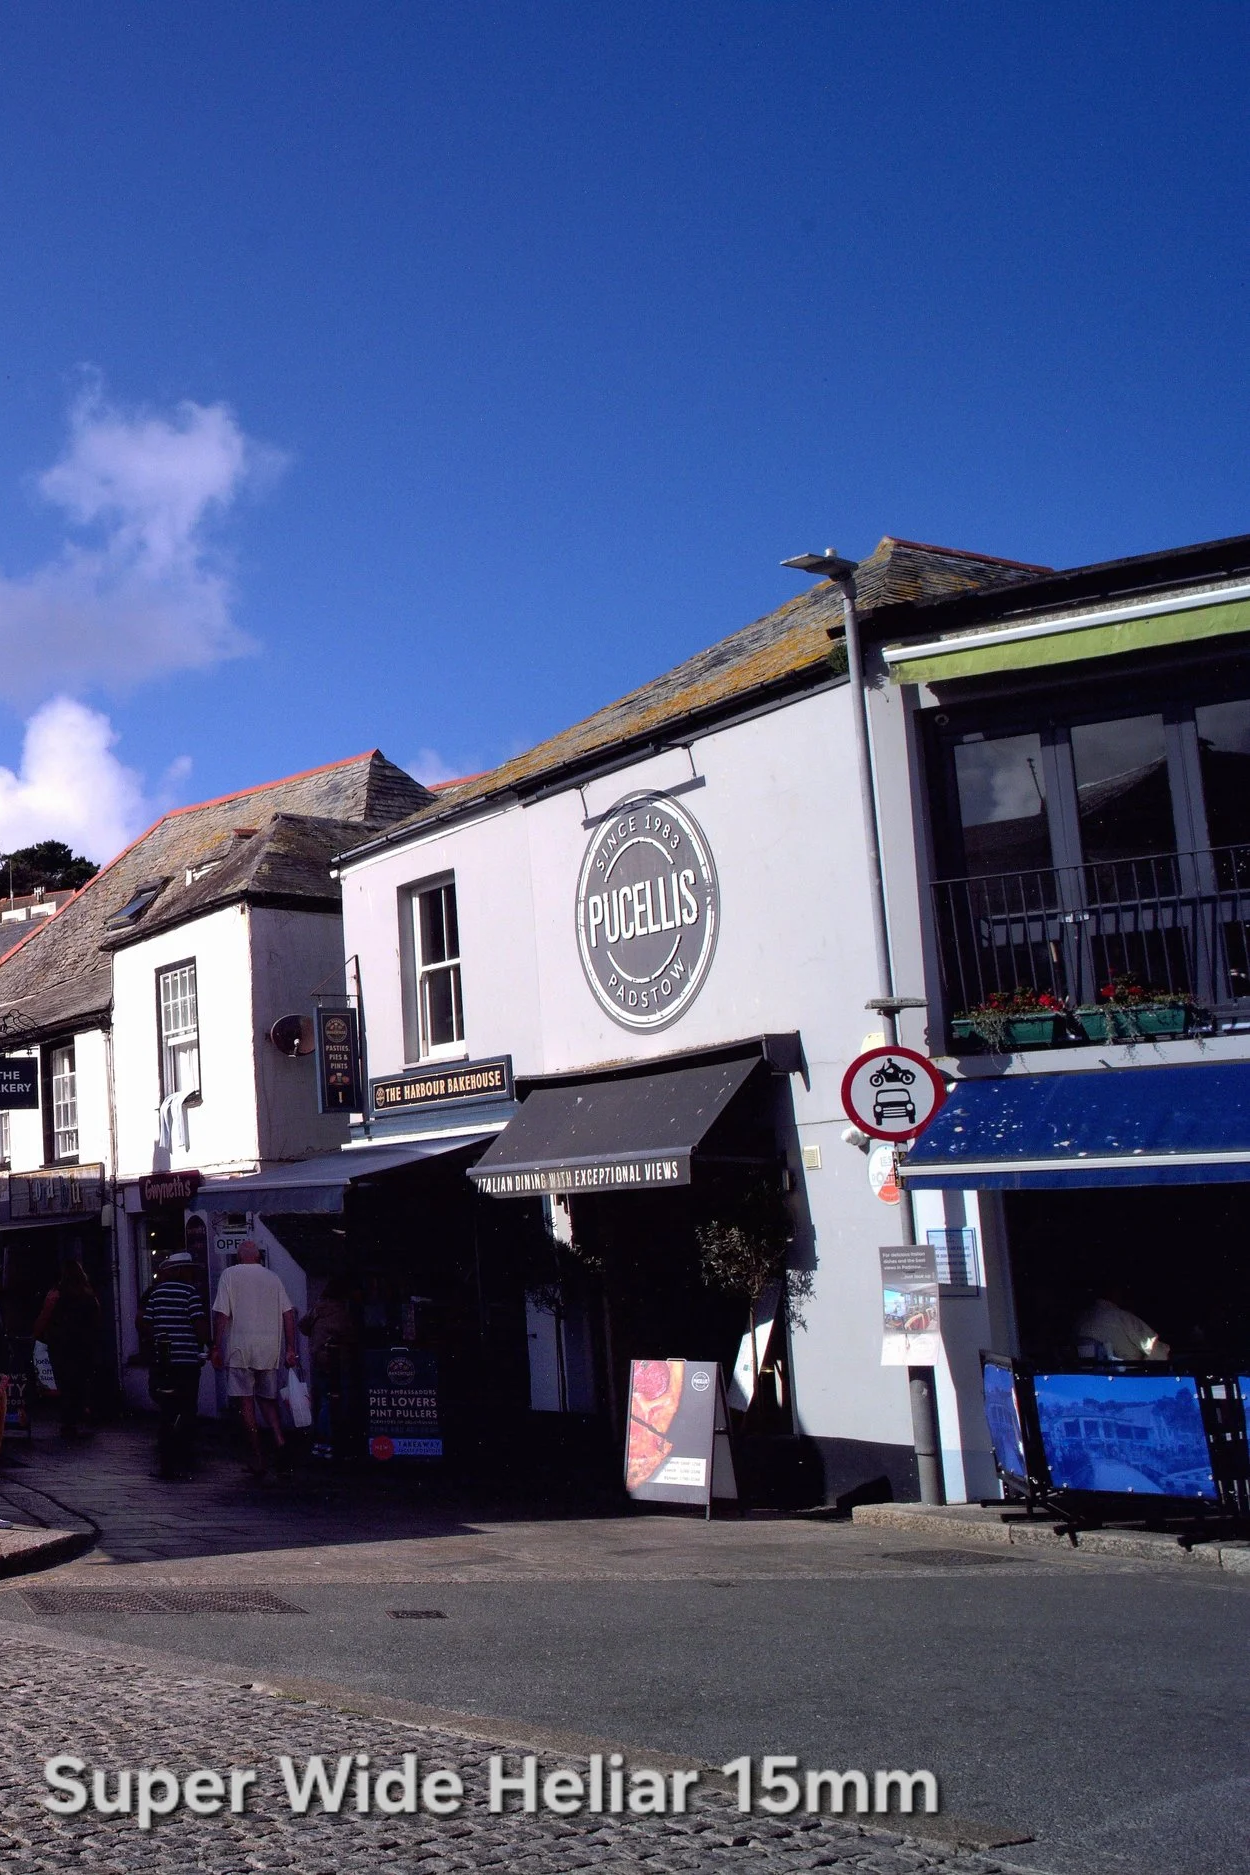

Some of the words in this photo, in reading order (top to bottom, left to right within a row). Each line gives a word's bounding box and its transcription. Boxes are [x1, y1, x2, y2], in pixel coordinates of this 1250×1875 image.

[596, 816, 637, 872] SINCE
[644, 814, 680, 850] 1983
[588, 868, 698, 949] PUCELLIS
[608, 957, 686, 1008] PADSTOW
[385, 1086, 401, 1102] THE
[404, 1080, 446, 1100] HARBOUR
[448, 1070, 502, 1093] BAKEHOUSE
[478, 1176, 513, 1193] ITALIAN
[515, 1172, 546, 1191] DINING
[548, 1171, 572, 1188] WITH
[575, 1164, 641, 1186] EXCEPTIONAL
[644, 1161, 678, 1181] VIEWS
[217, 1239, 245, 1249] OPE
[370, 1397, 387, 1406] PIE
[392, 1397, 437, 1407] LOVERS
[396, 1410, 438, 1419] PULLERS
